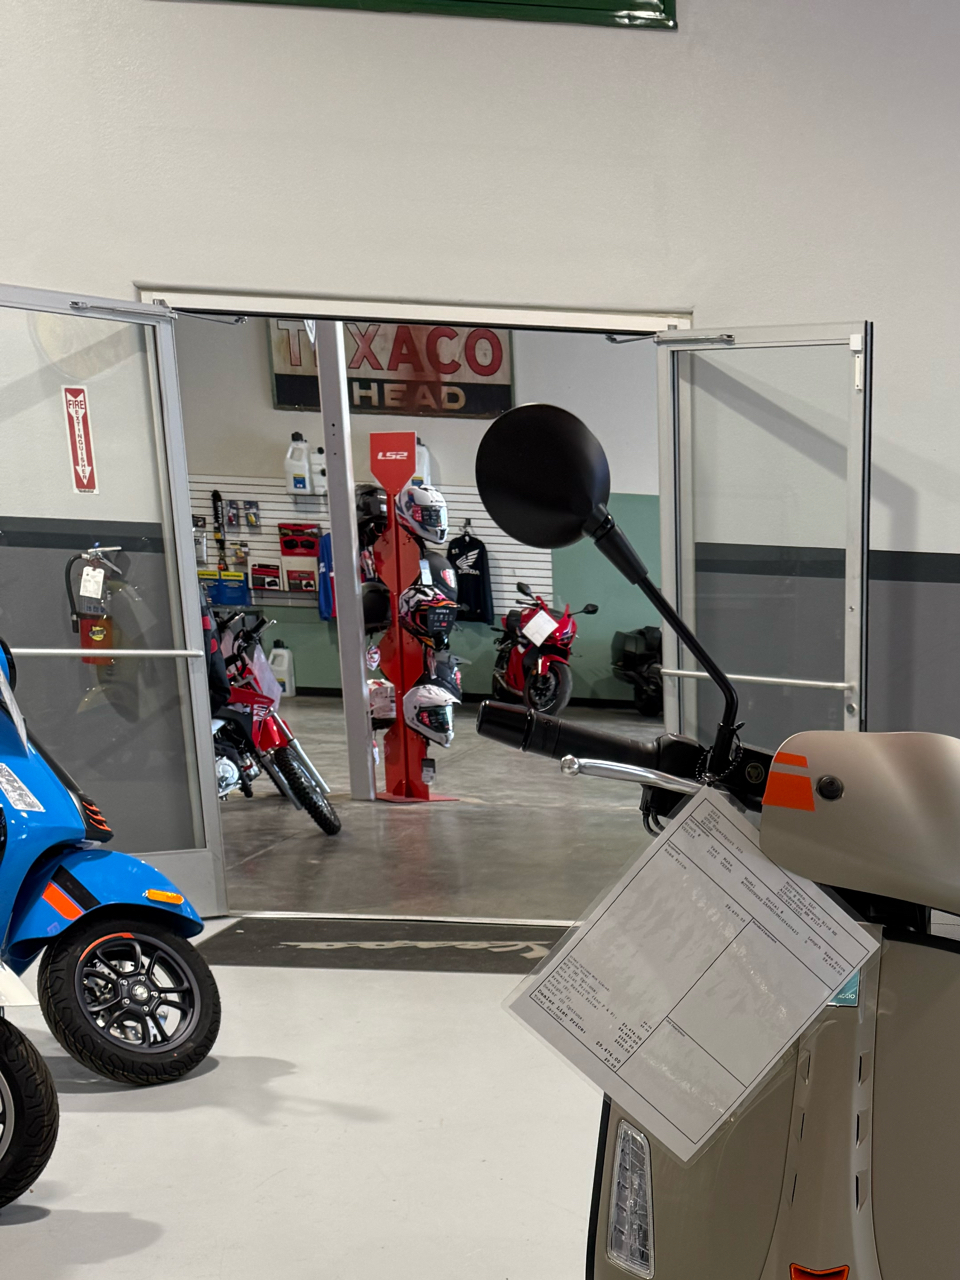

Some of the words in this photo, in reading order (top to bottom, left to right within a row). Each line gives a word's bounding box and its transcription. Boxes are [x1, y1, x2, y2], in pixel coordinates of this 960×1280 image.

[277, 319, 503, 377] TXACO
[68, 399, 85, 410] FIRE
[74, 409, 88, 480] EXTINGUISHER
[377, 451, 409, 460] LS2
[663, 847, 675, 858] Base
[674, 857, 688, 870] Price
[683, 821, 697, 834] Stock
[709, 844, 720, 856] Year
[722, 856, 733, 867] Make
[743, 876, 756, 889] Model
[764, 896, 780, 911] Serial
[806, 935, 822, 950] Length
[823, 950, 834, 961] Base
[833, 960, 846, 973] Price
[778, 887, 804, 912] Albuquerque
[545, 978, 564, 995] Freight
[550, 974, 562, 986] Prep
[554, 969, 570, 984] Dealer
[569, 983, 585, 997] Retail
[584, 996, 599, 1011] Price:
[566, 973, 578, 983] List
[577, 982, 591, 995] Price
[532, 993, 546, 1006] Total
[545, 1005, 565, 1023] Savings:
[542, 983, 558, 998] Dealer
[564, 1003, 585, 1023] Options:
[536, 988, 556, 1007] Dealer
[555, 1004, 569, 1018] List
[568, 1016, 587, 1035] Price:
[594, 1039, 622, 1065] $9,474.00
